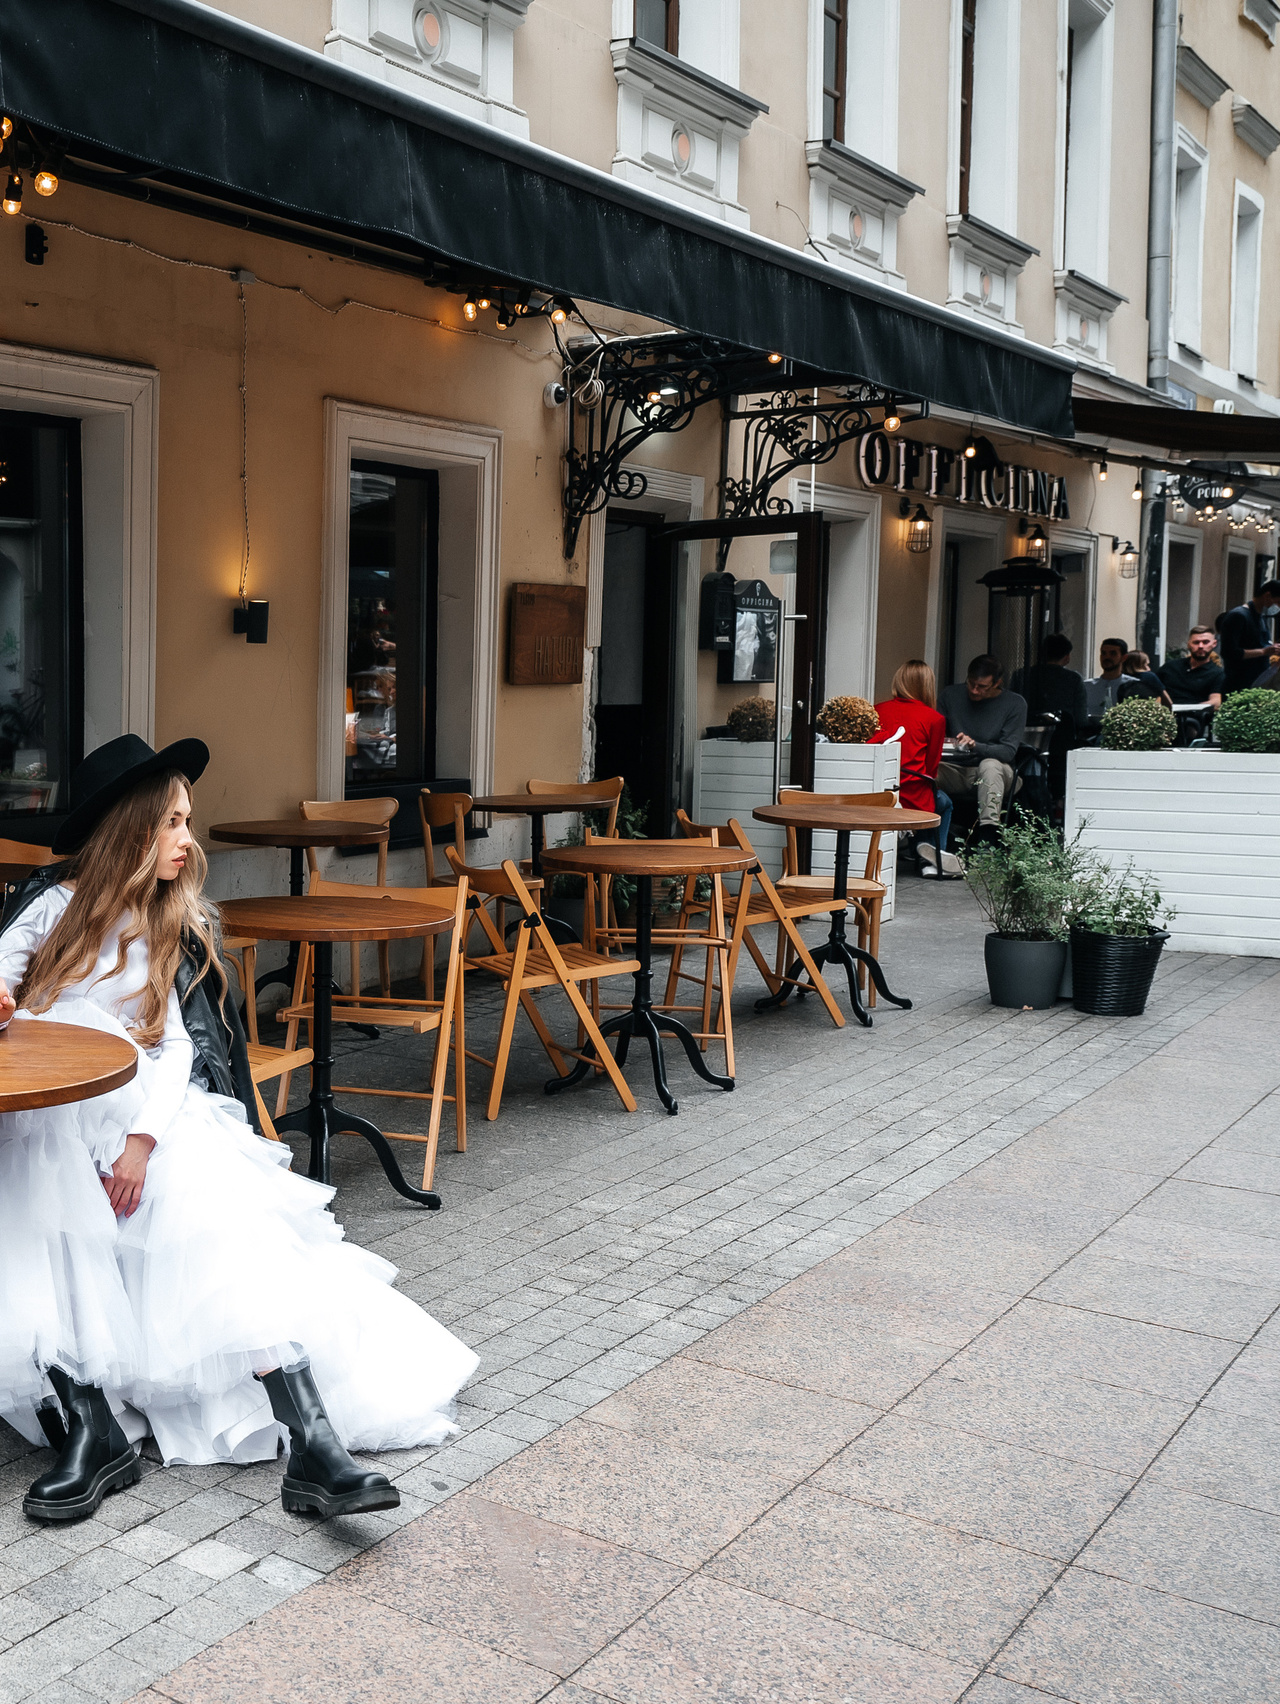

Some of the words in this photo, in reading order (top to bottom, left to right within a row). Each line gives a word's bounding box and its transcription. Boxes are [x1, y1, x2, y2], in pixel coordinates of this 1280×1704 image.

[859, 431, 1070, 521] OFFICINA
[1197, 486, 1230, 499] POIN
[534, 634, 580, 676] НАТУРА
